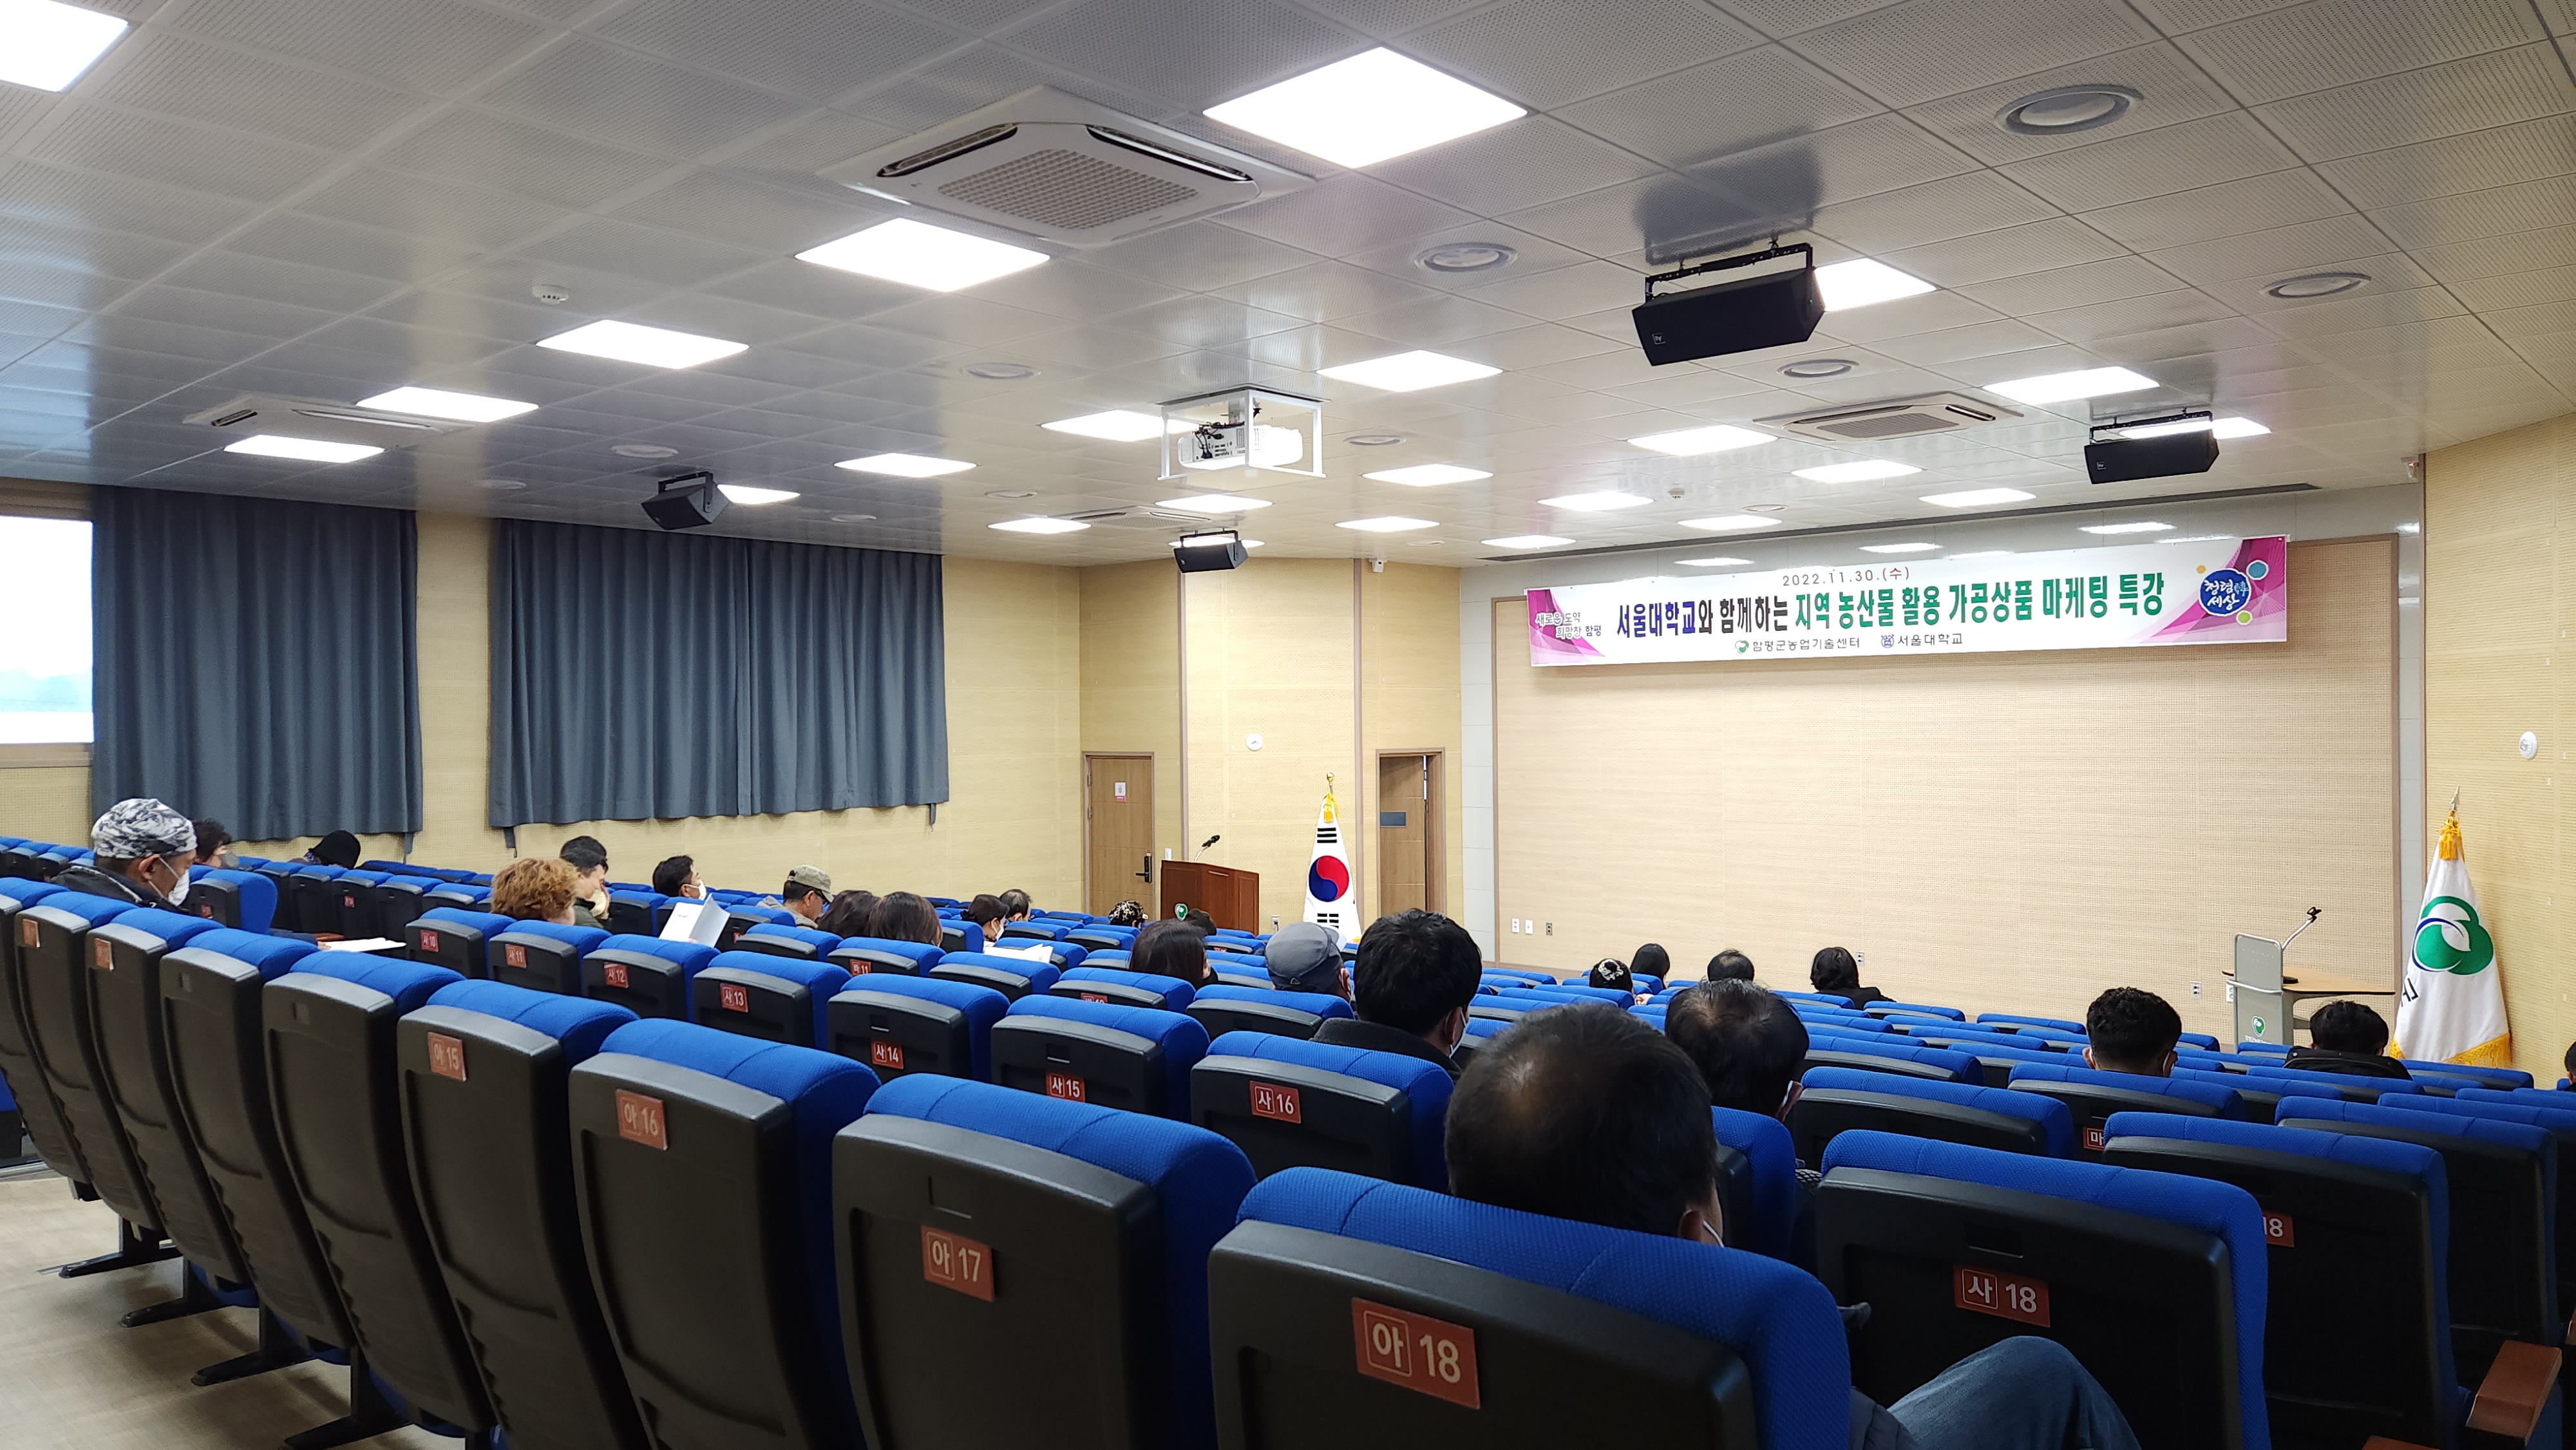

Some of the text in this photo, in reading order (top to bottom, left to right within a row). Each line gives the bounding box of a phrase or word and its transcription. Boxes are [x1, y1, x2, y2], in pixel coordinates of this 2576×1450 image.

[1616, 572, 2164, 638] 서울대학교와 함께하는 지역 농산물 활용 가공상품 마케팅 특강
[2206, 593, 2240, 610] 세상
[1536, 612, 1581, 625] 새로운 도약
[1557, 625, 1602, 638] 희망찬 함평
[1752, 637, 1860, 652] 함평군농업기술센터
[1897, 633, 1963, 647] 서울대학교
